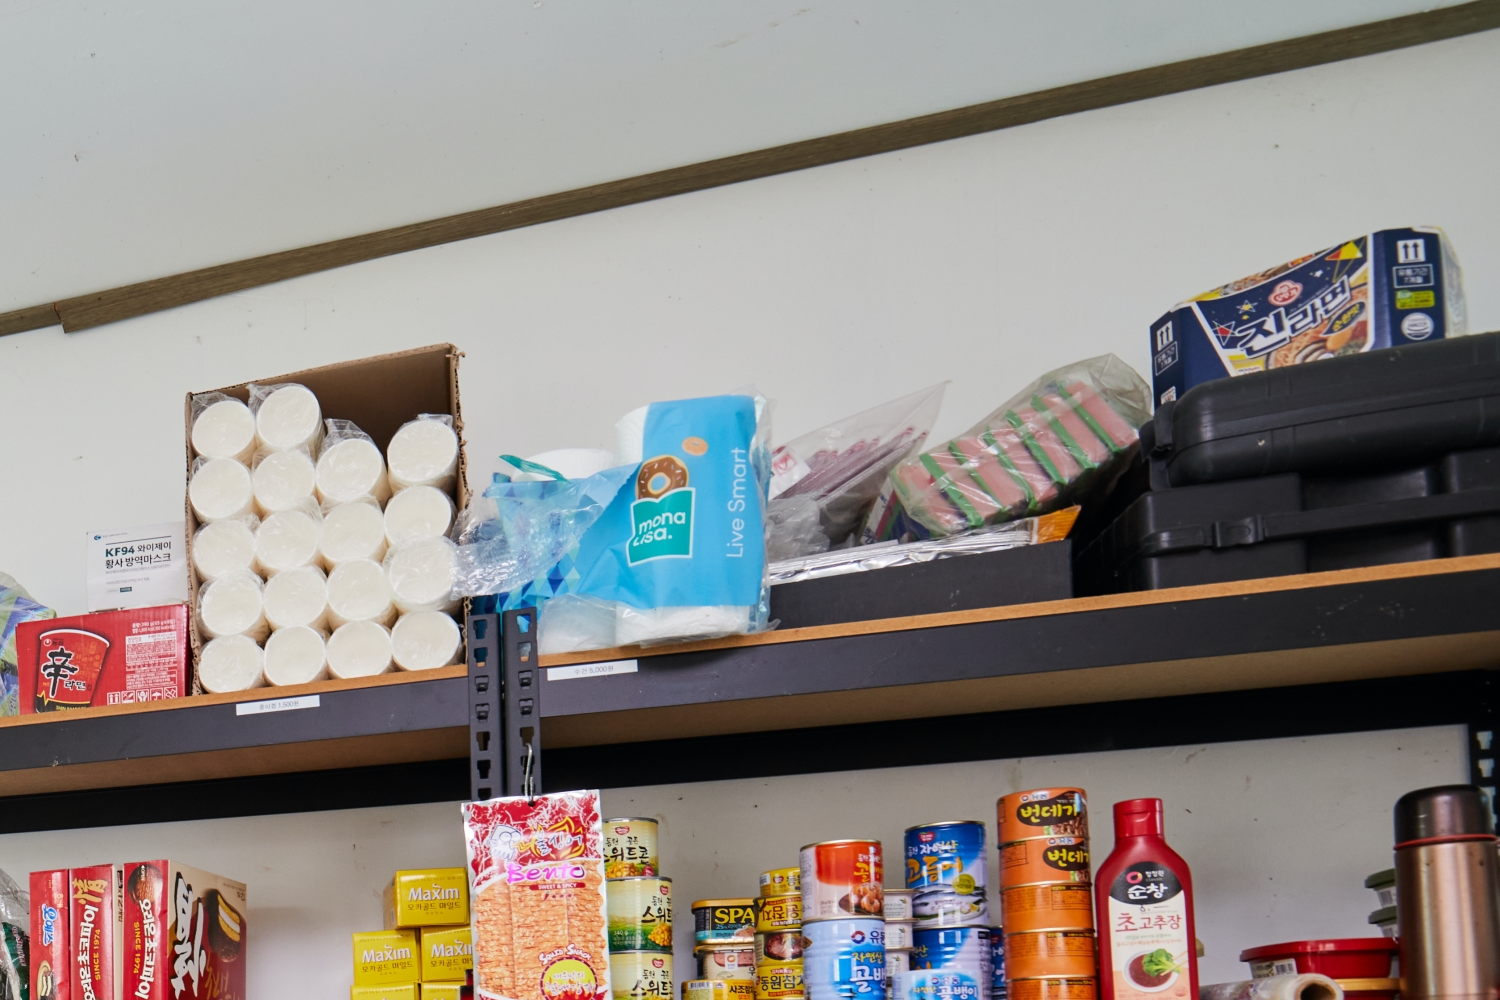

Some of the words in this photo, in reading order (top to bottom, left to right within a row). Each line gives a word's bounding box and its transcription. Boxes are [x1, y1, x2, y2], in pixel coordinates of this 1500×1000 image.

[1235, 275, 1351, 359] 진라면
[726, 447, 747, 513] Smart
[638, 510, 687, 530] mona
[726, 517, 744, 558] Live
[105, 546, 135, 558] KF94
[137, 541, 171, 552] 와이제이
[105, 558, 124, 569] 황사
[125, 553, 171, 567] 방역마스크
[41, 646, 79, 698] 辛
[589, 663, 614, 674] 5,000원
[64, 680, 86, 691] 라면
[277, 699, 299, 709] 1,500원
[1021, 803, 1079, 819] 번데기
[920, 841, 959, 855] 자연산
[1047, 849, 1090, 865] 번데기
[507, 862, 586, 885] Bento
[408, 883, 460, 902] Maxim
[1127, 883, 1168, 899] 순창
[407, 901, 437, 911] 모카골드
[439, 900, 461, 911] 마일드
[1115, 912, 1182, 933] 초고추장
[93, 929, 101, 951] 1974
[361, 944, 412, 965] Maxim
[431, 940, 473, 958] Maxi
[361, 962, 390, 973] 모카골드
[391, 960, 414, 971] 마일드
[430, 958, 460, 969] 모카골드
